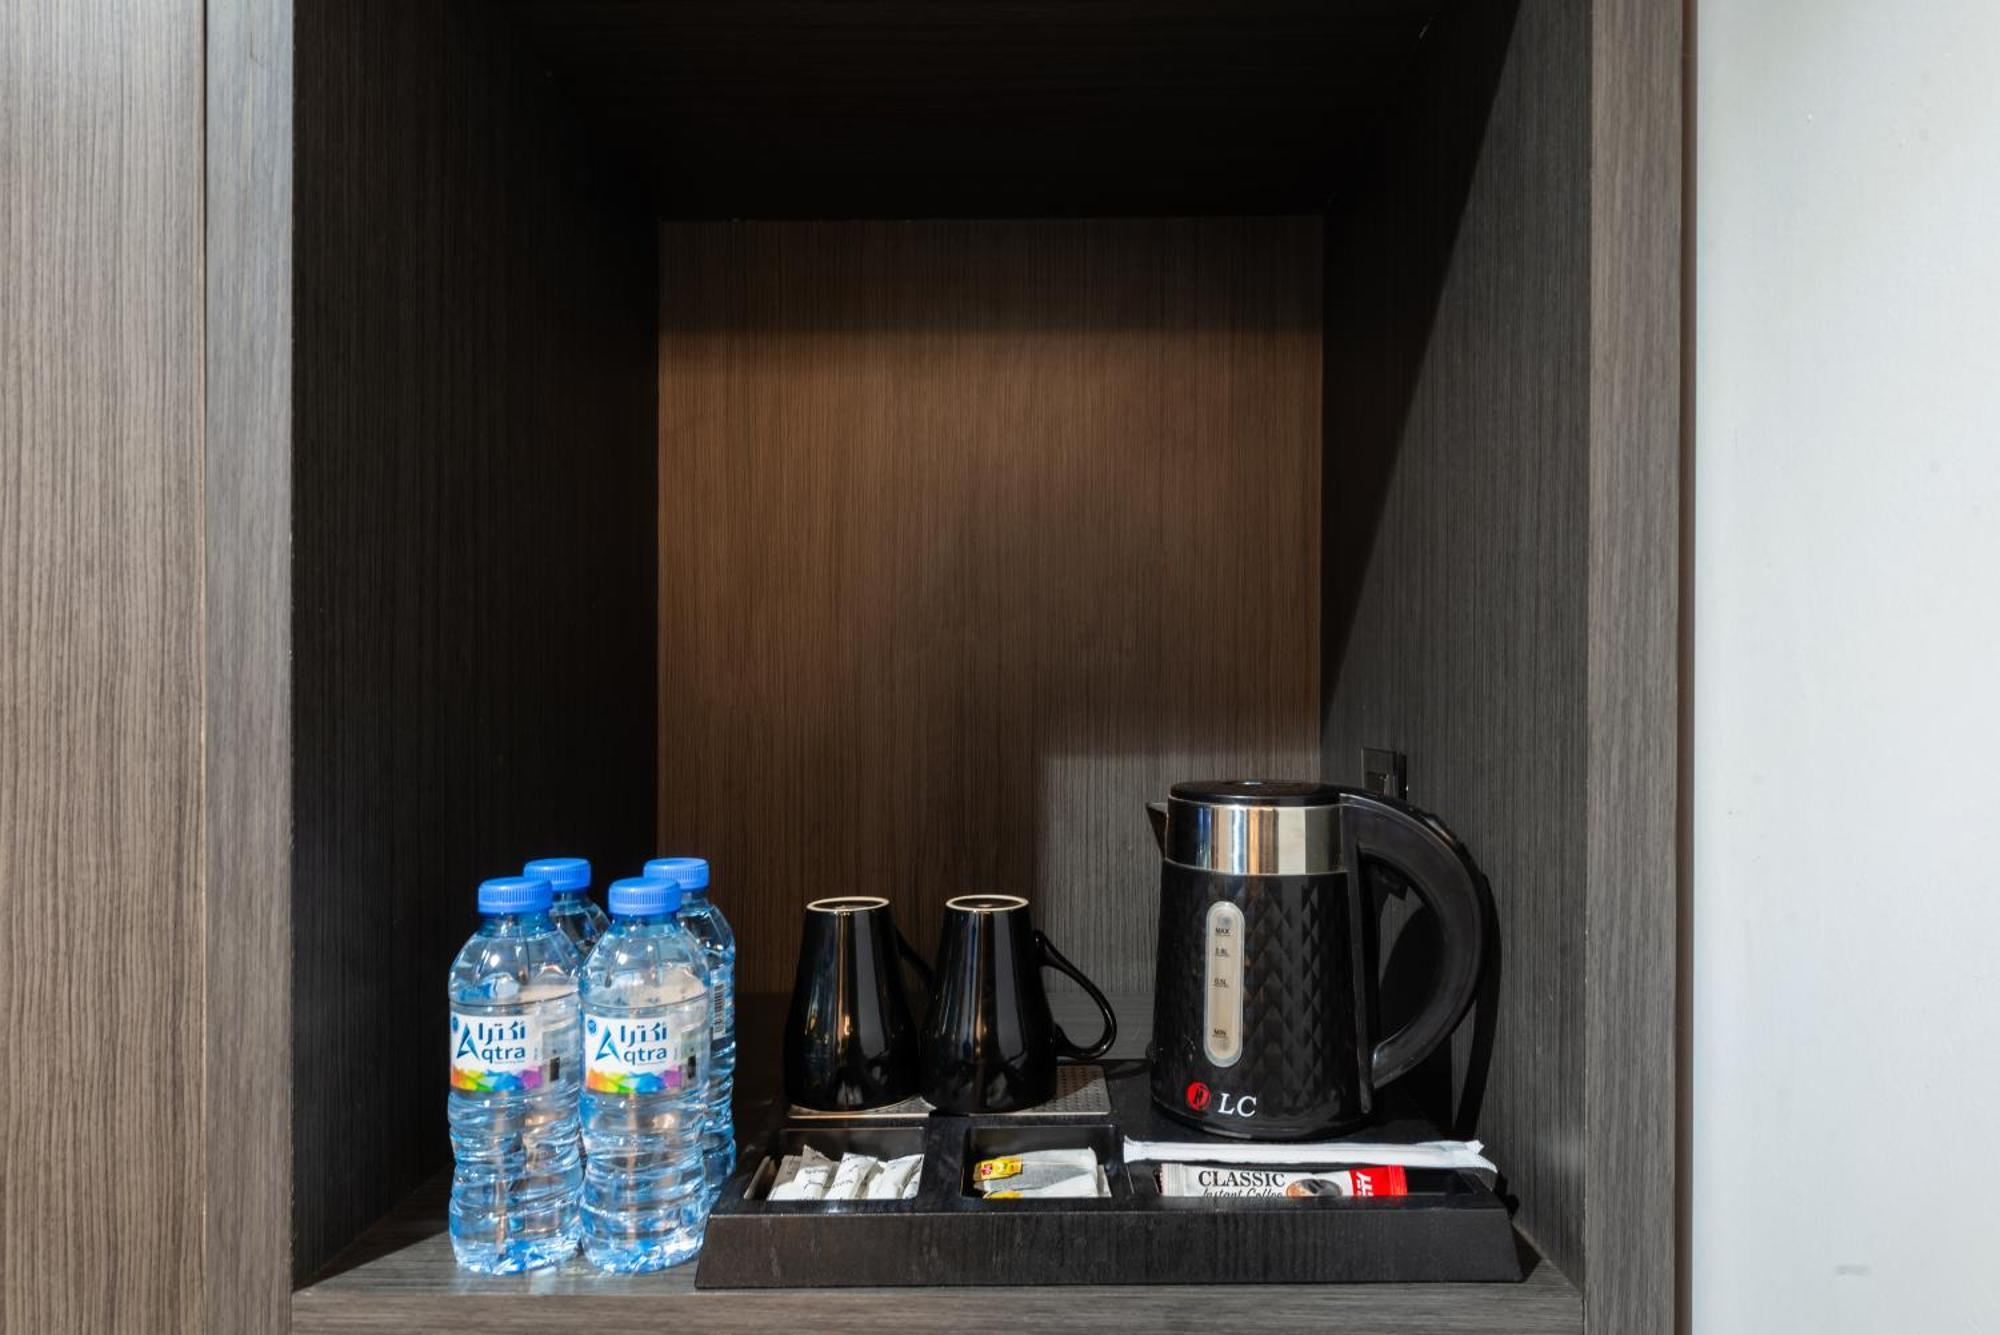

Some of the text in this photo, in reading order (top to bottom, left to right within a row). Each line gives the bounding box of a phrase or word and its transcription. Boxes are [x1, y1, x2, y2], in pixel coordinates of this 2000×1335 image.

[1215, 927, 1231, 935] MAX
[1213, 1028, 1227, 1036] MIN
[456, 1023, 526, 1064] Aqtra
[595, 1023, 668, 1065] Aqtra
[1198, 1170, 1285, 1187] CLASSIC
